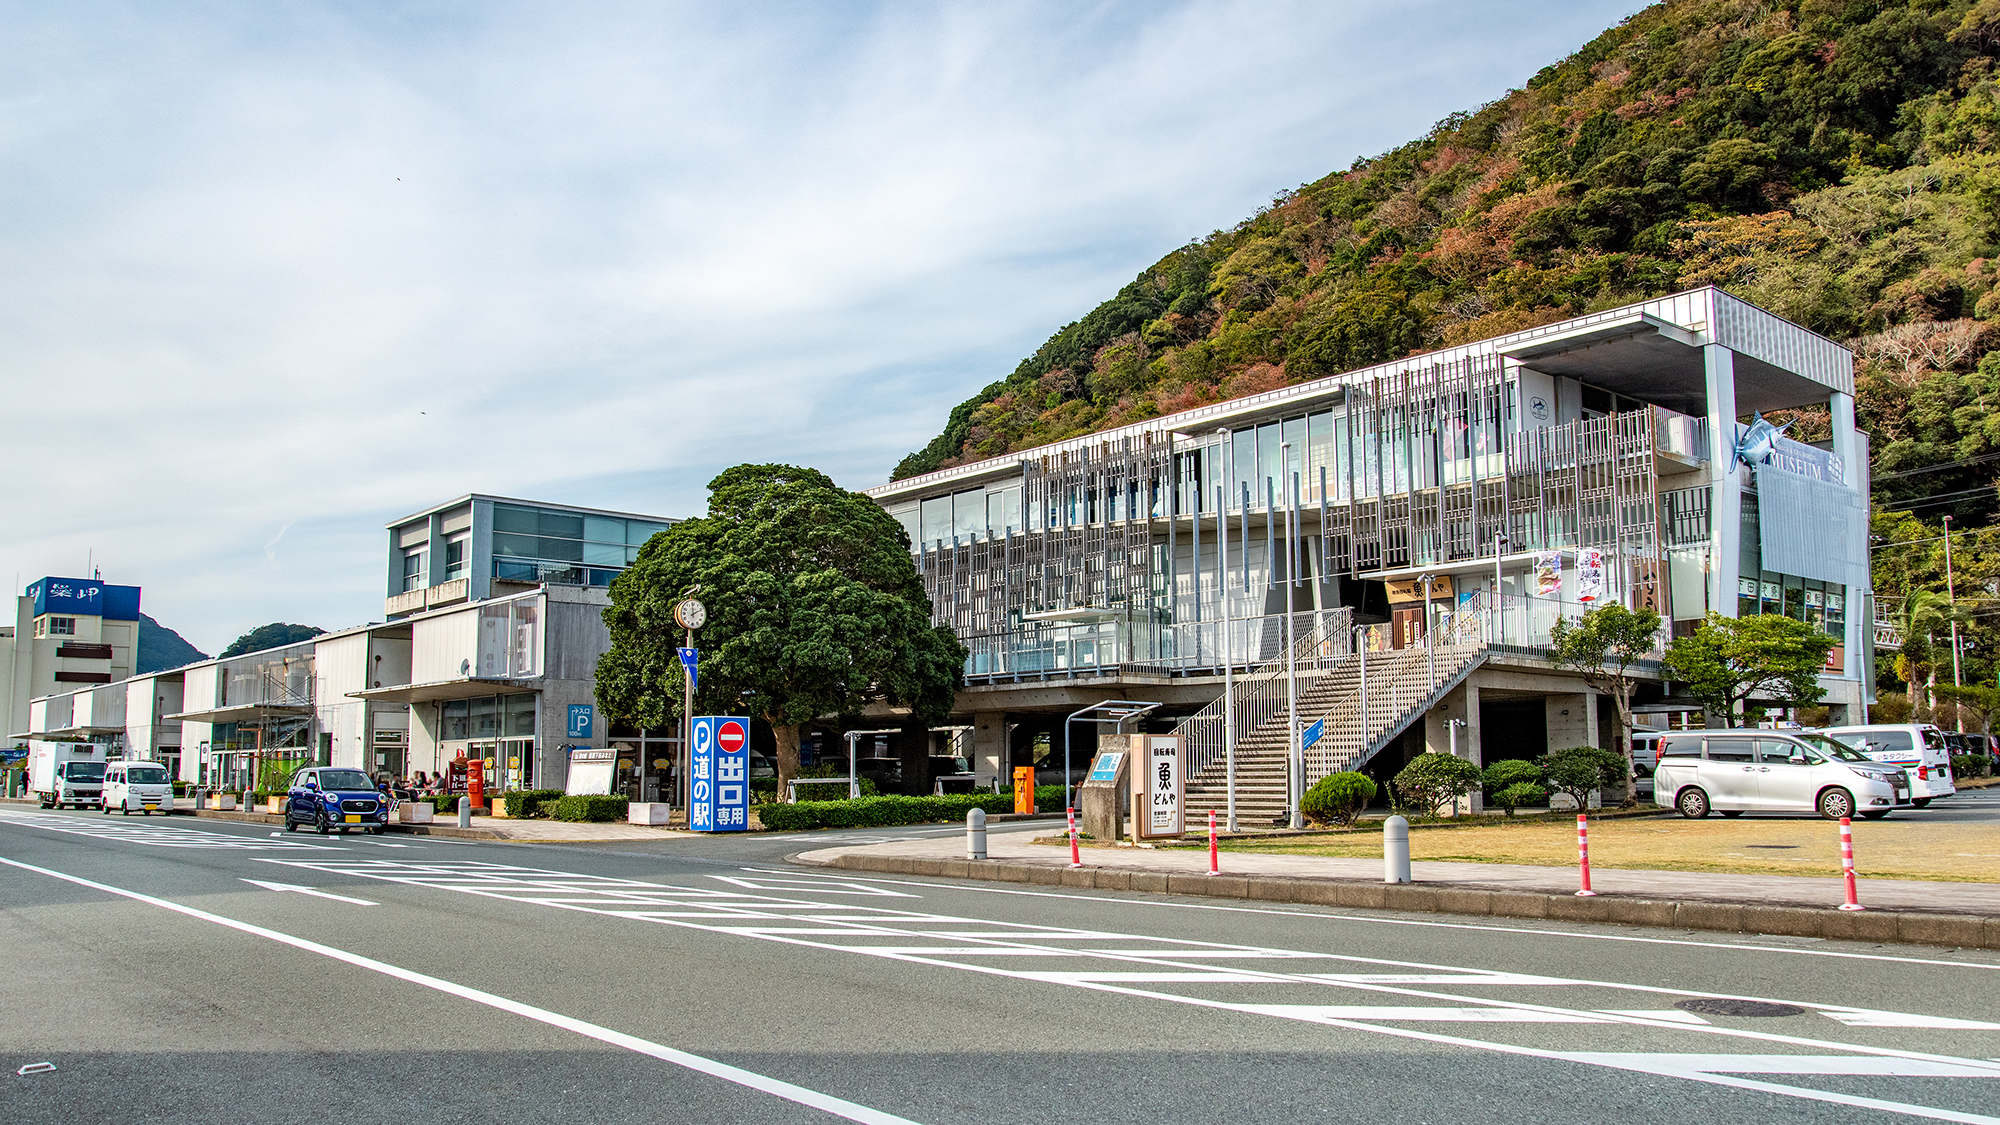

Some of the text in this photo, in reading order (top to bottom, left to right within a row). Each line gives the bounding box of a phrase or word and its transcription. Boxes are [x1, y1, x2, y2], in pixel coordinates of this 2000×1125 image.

[1769, 452, 1822, 481] MUSEUM
[577, 715, 589, 732] P
[717, 756, 744, 805] 出口
[1158, 762, 1172, 790] 魚
[693, 755, 710, 826] 道の駅
[1153, 793, 1176, 806] どんや
[716, 807, 744, 826] 専用
